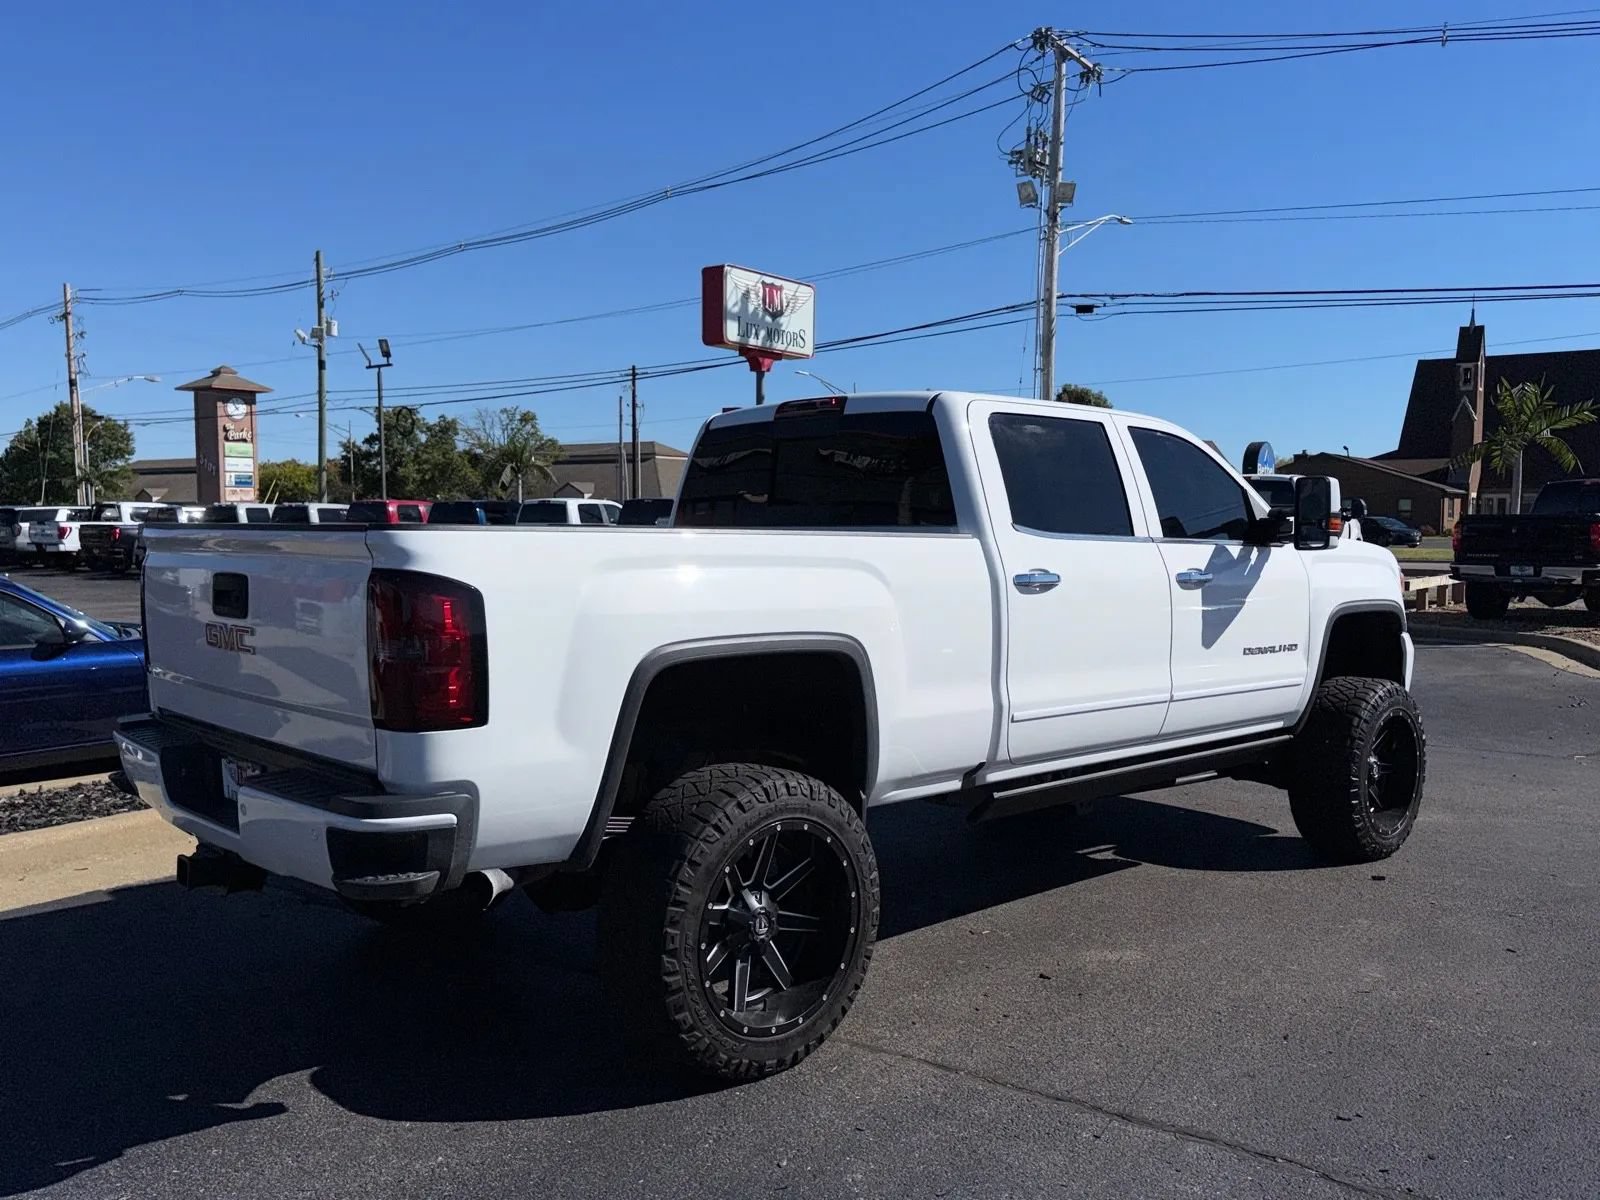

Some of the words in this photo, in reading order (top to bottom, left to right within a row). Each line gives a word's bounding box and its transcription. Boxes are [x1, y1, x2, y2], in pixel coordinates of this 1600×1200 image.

[737, 316, 760, 341] LUX
[765, 326, 806, 349] MOTORS
[206, 621, 256, 655] GMC
[1243, 645, 1282, 656] DENALI
[1282, 643, 1298, 653] HD
